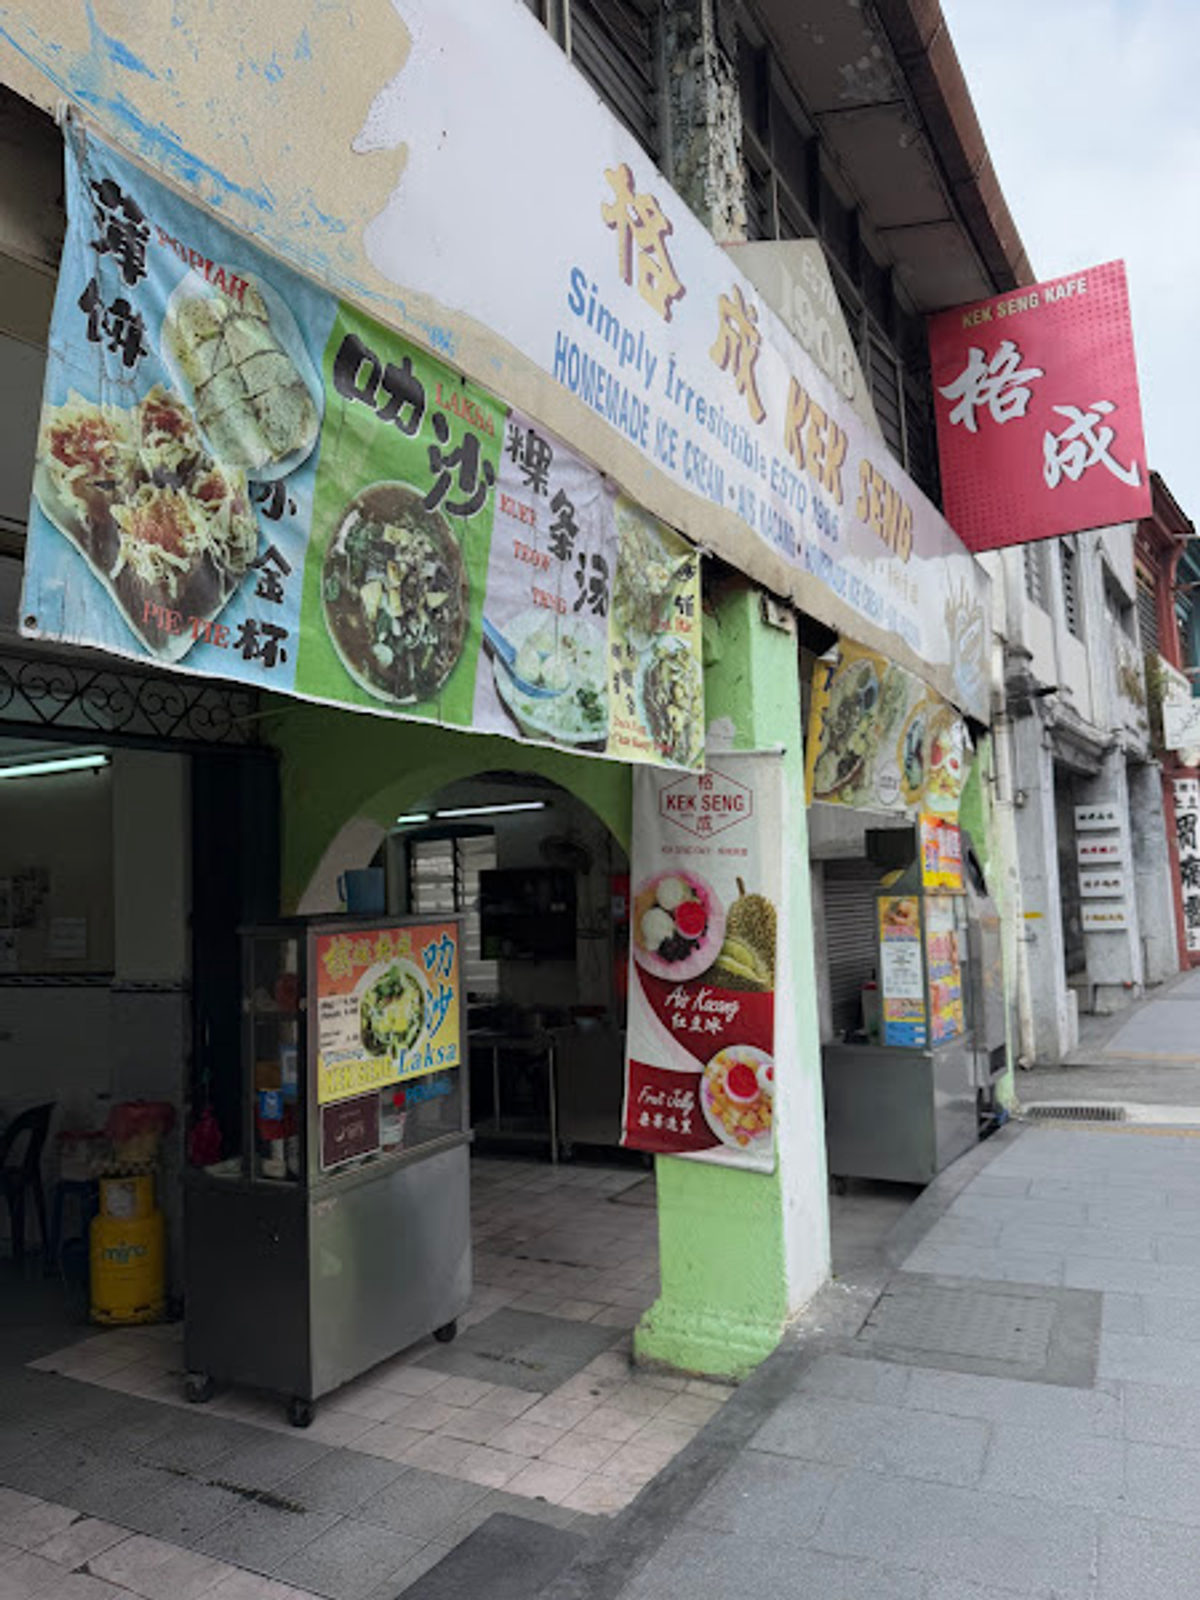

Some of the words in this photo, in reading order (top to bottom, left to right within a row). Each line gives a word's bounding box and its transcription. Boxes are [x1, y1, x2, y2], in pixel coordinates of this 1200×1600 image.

[155, 223, 249, 306] POPIAH
[962, 309, 993, 329] KEK
[996, 292, 1039, 319] SENG
[1044, 277, 1088, 304] KAFE
[568, 266, 657, 390] Simply
[663, 352, 768, 480] Irresistible
[435, 383, 495, 438] LAKSA
[553, 330, 650, 449] HOMEMADE
[654, 415, 679, 471] ICE
[683, 438, 725, 506] CREAM
[784, 375, 849, 507] KEK
[857, 457, 914, 564] SENG
[142, 599, 183, 636] PIE
[188, 616, 231, 650] TIE
[666, 794, 697, 812] KEK
[700, 794, 745, 813] SENG
[397, 1041, 458, 1077] Laksa
